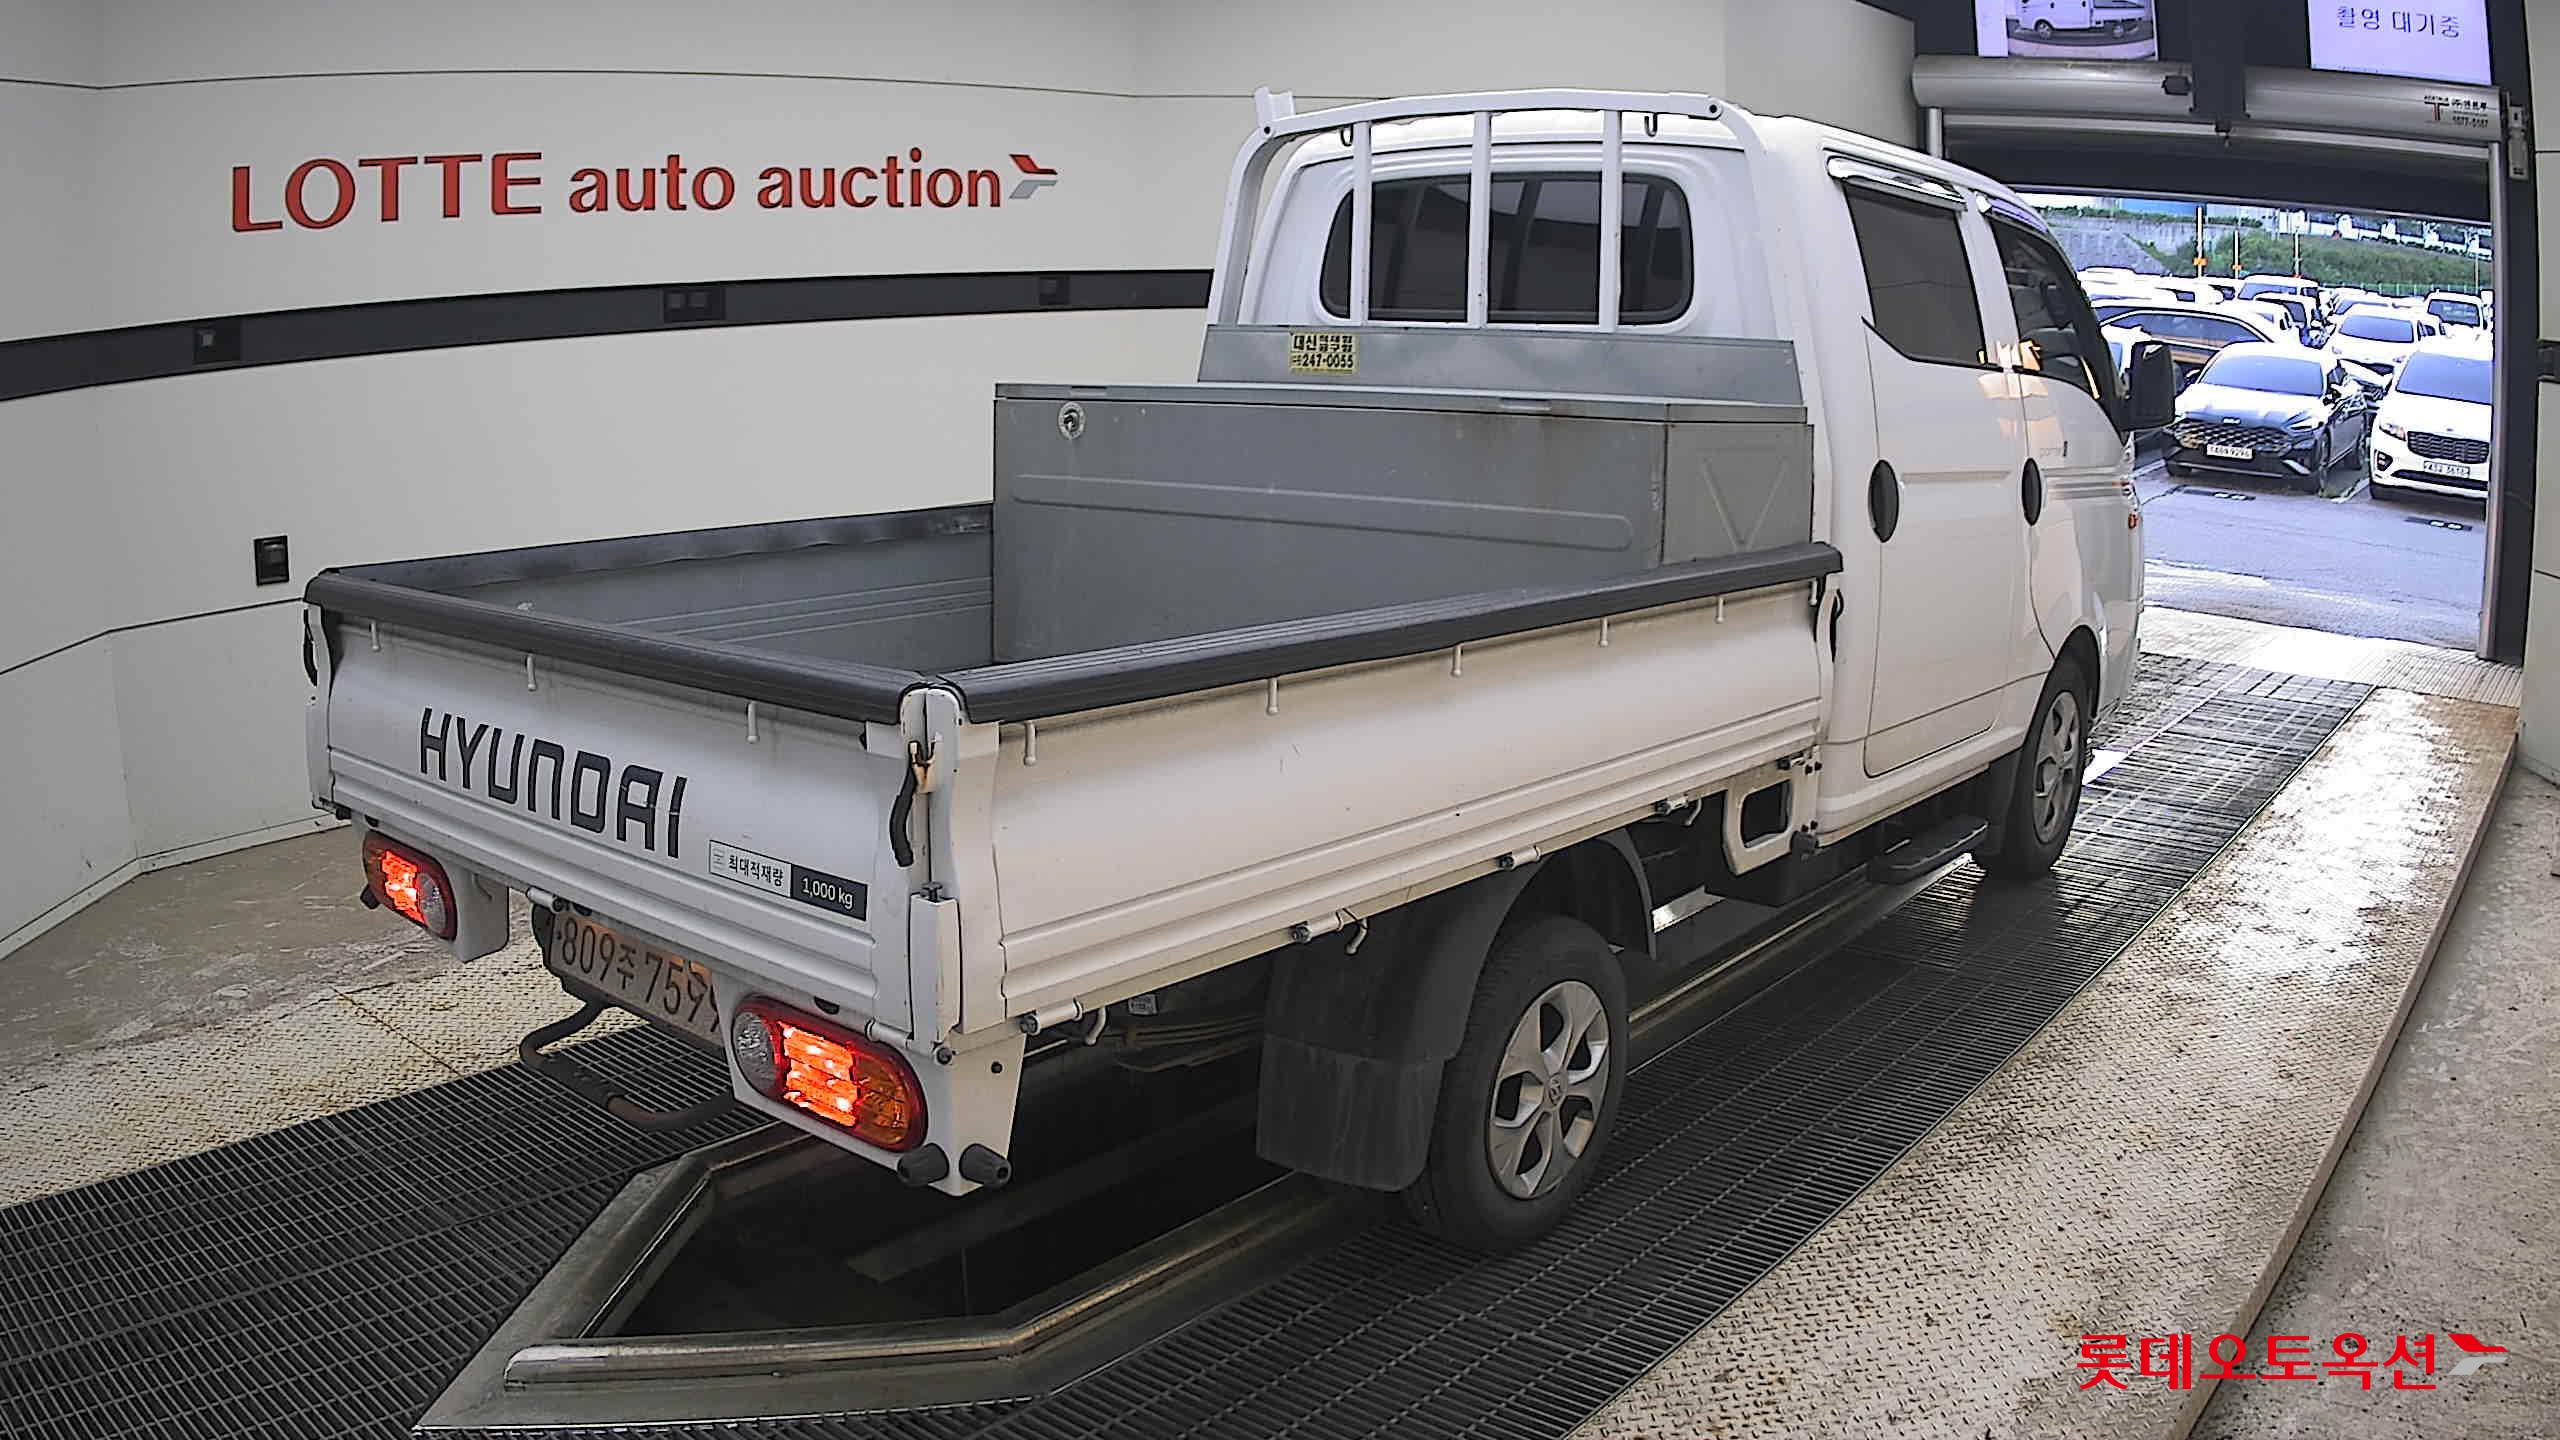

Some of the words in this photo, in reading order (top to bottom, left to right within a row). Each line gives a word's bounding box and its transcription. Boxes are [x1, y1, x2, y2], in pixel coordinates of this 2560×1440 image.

[2392, 11, 2460, 38] 대기중
[231, 152, 543, 234] LOTTE
[568, 153, 736, 214] auto
[755, 147, 1002, 209] auction
[1293, 335, 1317, 351] 대신
[1302, 353, 1354, 368] 247-0055
[419, 706, 688, 859] HYUNDAI
[728, 854, 784, 887] 최대적재량
[802, 877, 836, 902] 1,000
[838, 887, 854, 910] kg
